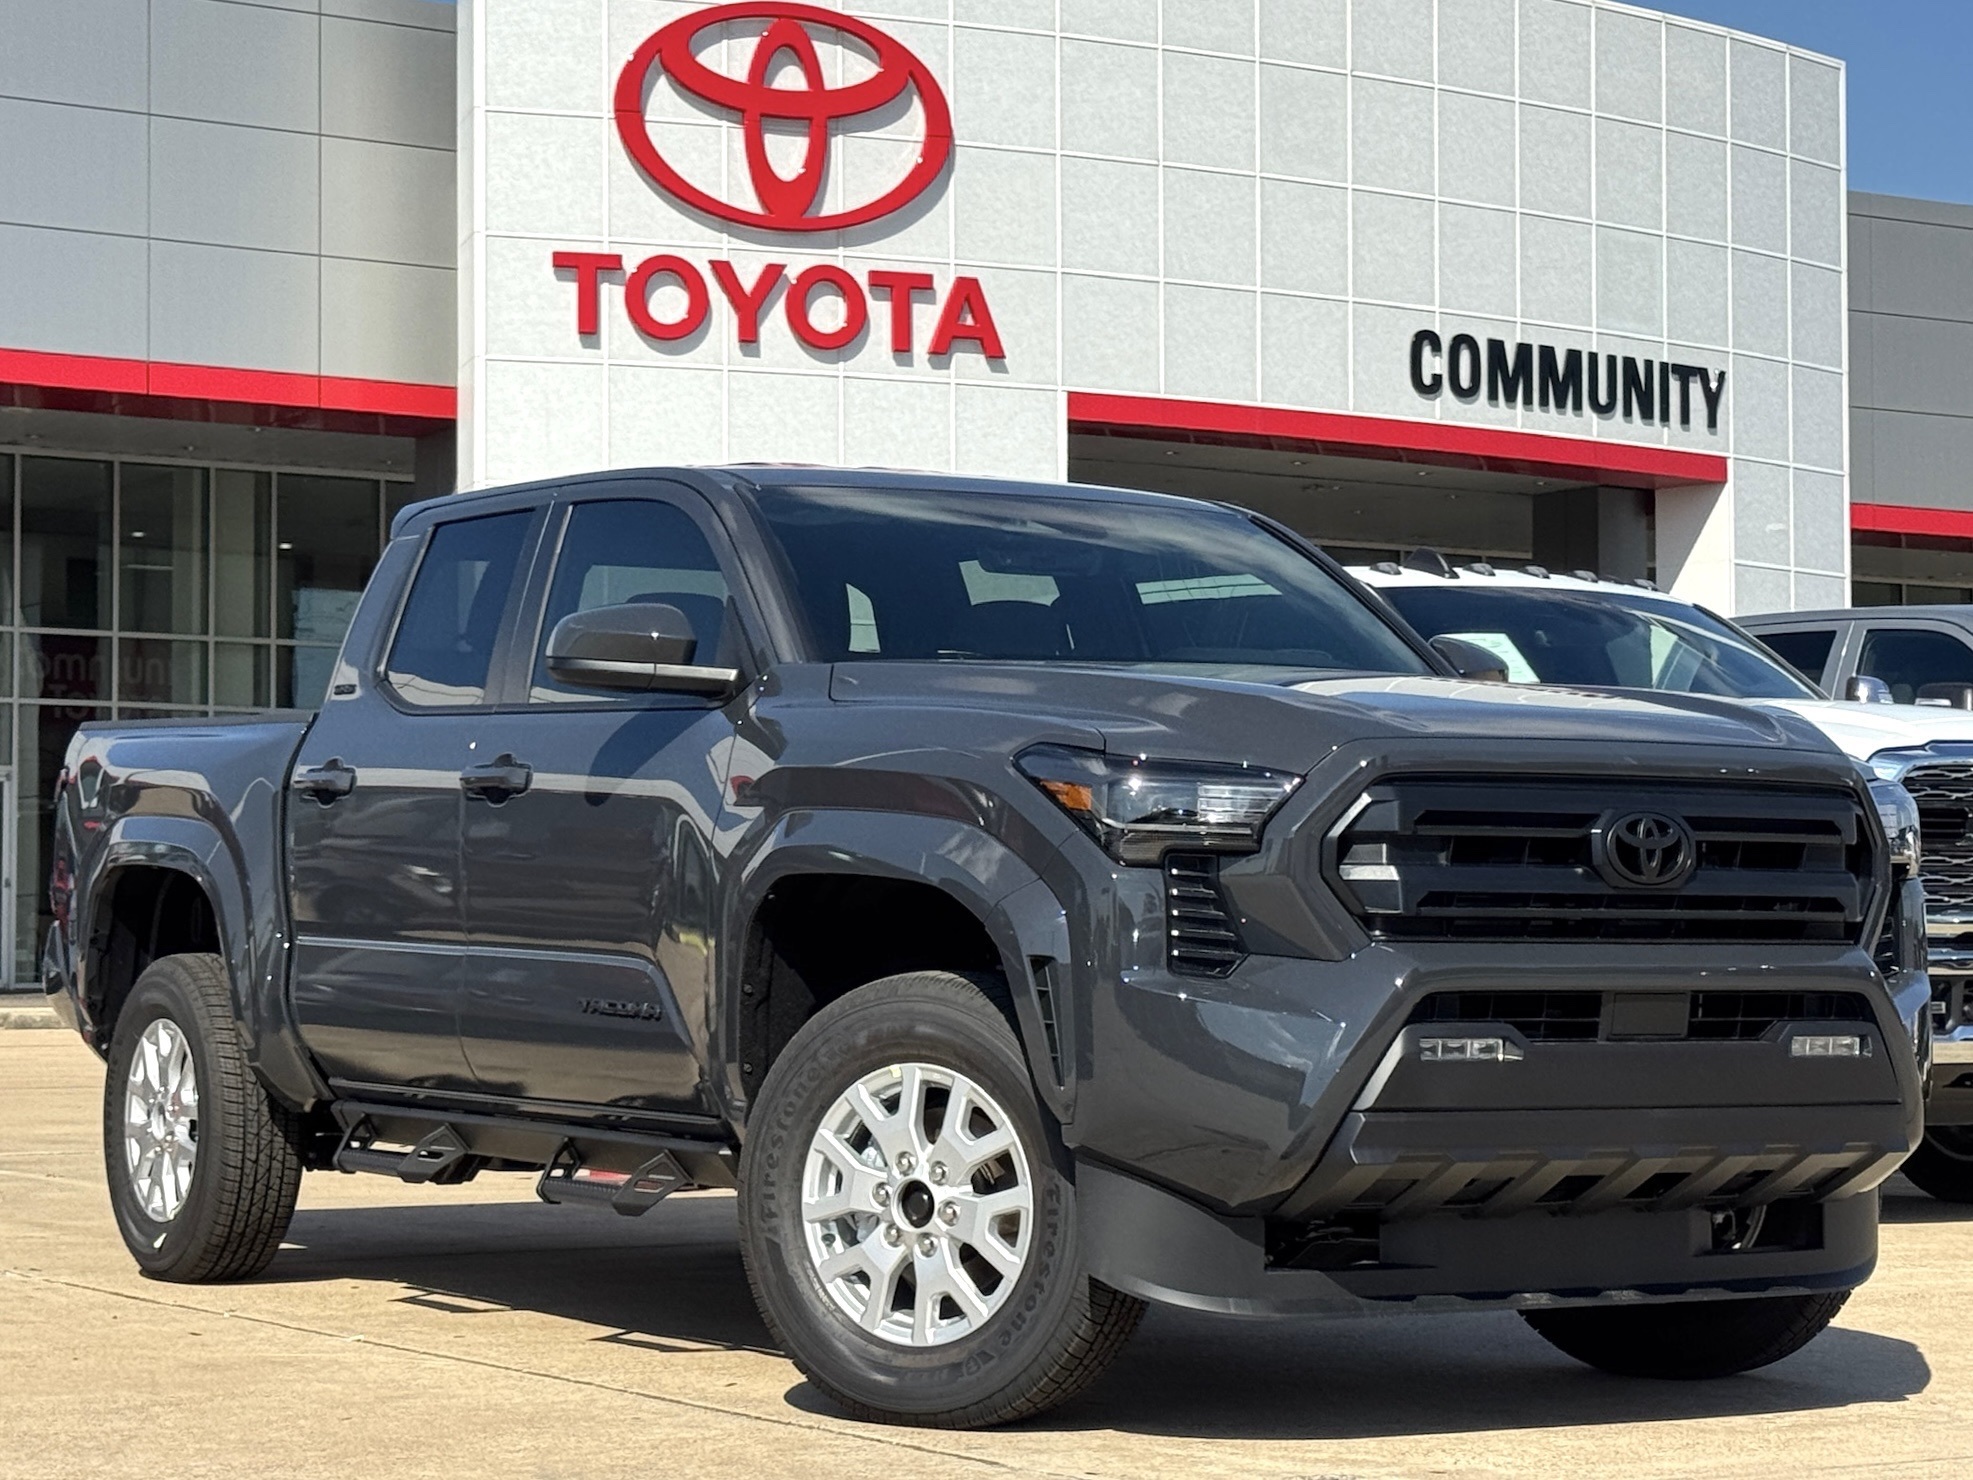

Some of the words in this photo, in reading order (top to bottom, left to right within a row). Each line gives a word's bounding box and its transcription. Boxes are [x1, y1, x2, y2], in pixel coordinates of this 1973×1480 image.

[552, 251, 1006, 360] TOYOTA
[1410, 329, 1727, 430] COMMUNITY
[760, 1066, 821, 1223] Firestone
[997, 1182, 1062, 1347] Firestone
